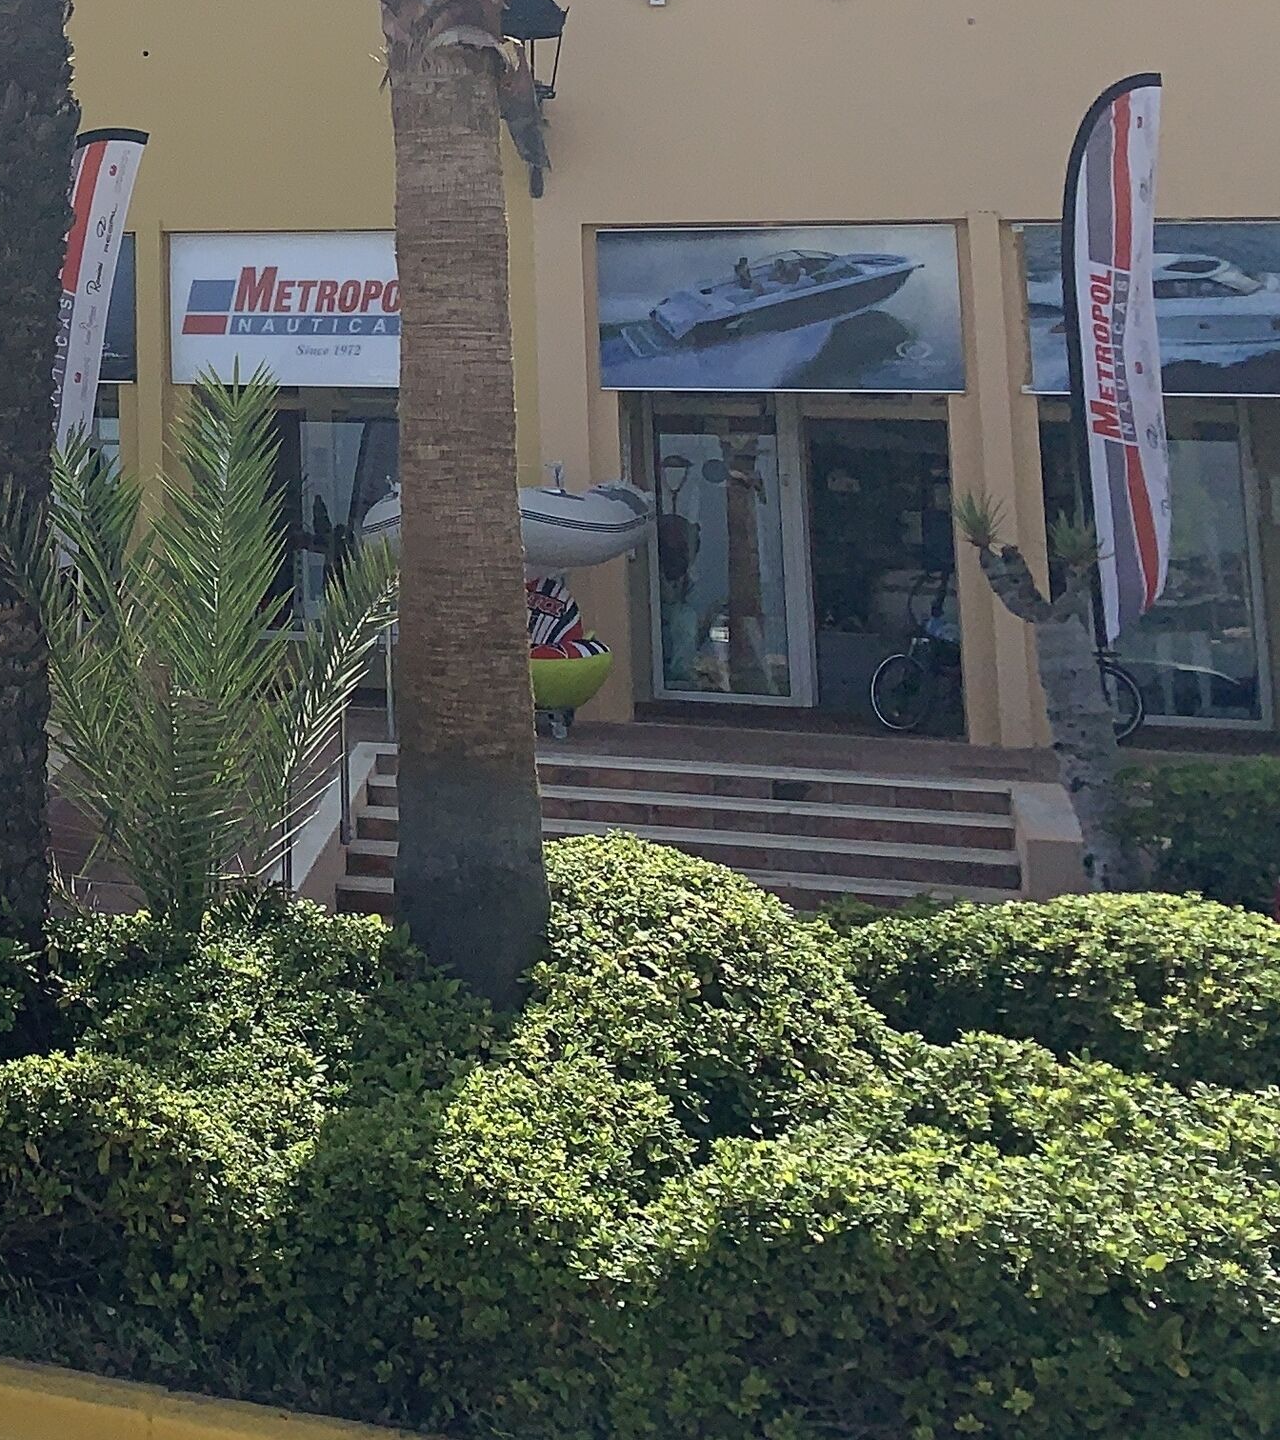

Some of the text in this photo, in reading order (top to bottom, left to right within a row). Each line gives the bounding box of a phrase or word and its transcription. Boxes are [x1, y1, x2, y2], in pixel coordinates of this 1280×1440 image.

[234, 266, 401, 313] METROPO
[238, 318, 401, 333] NAUTICA
[296, 344, 361, 355] Since 1972
[1090, 270, 1122, 439] METROPOL
[1113, 280, 1135, 436] NAUTICAS
